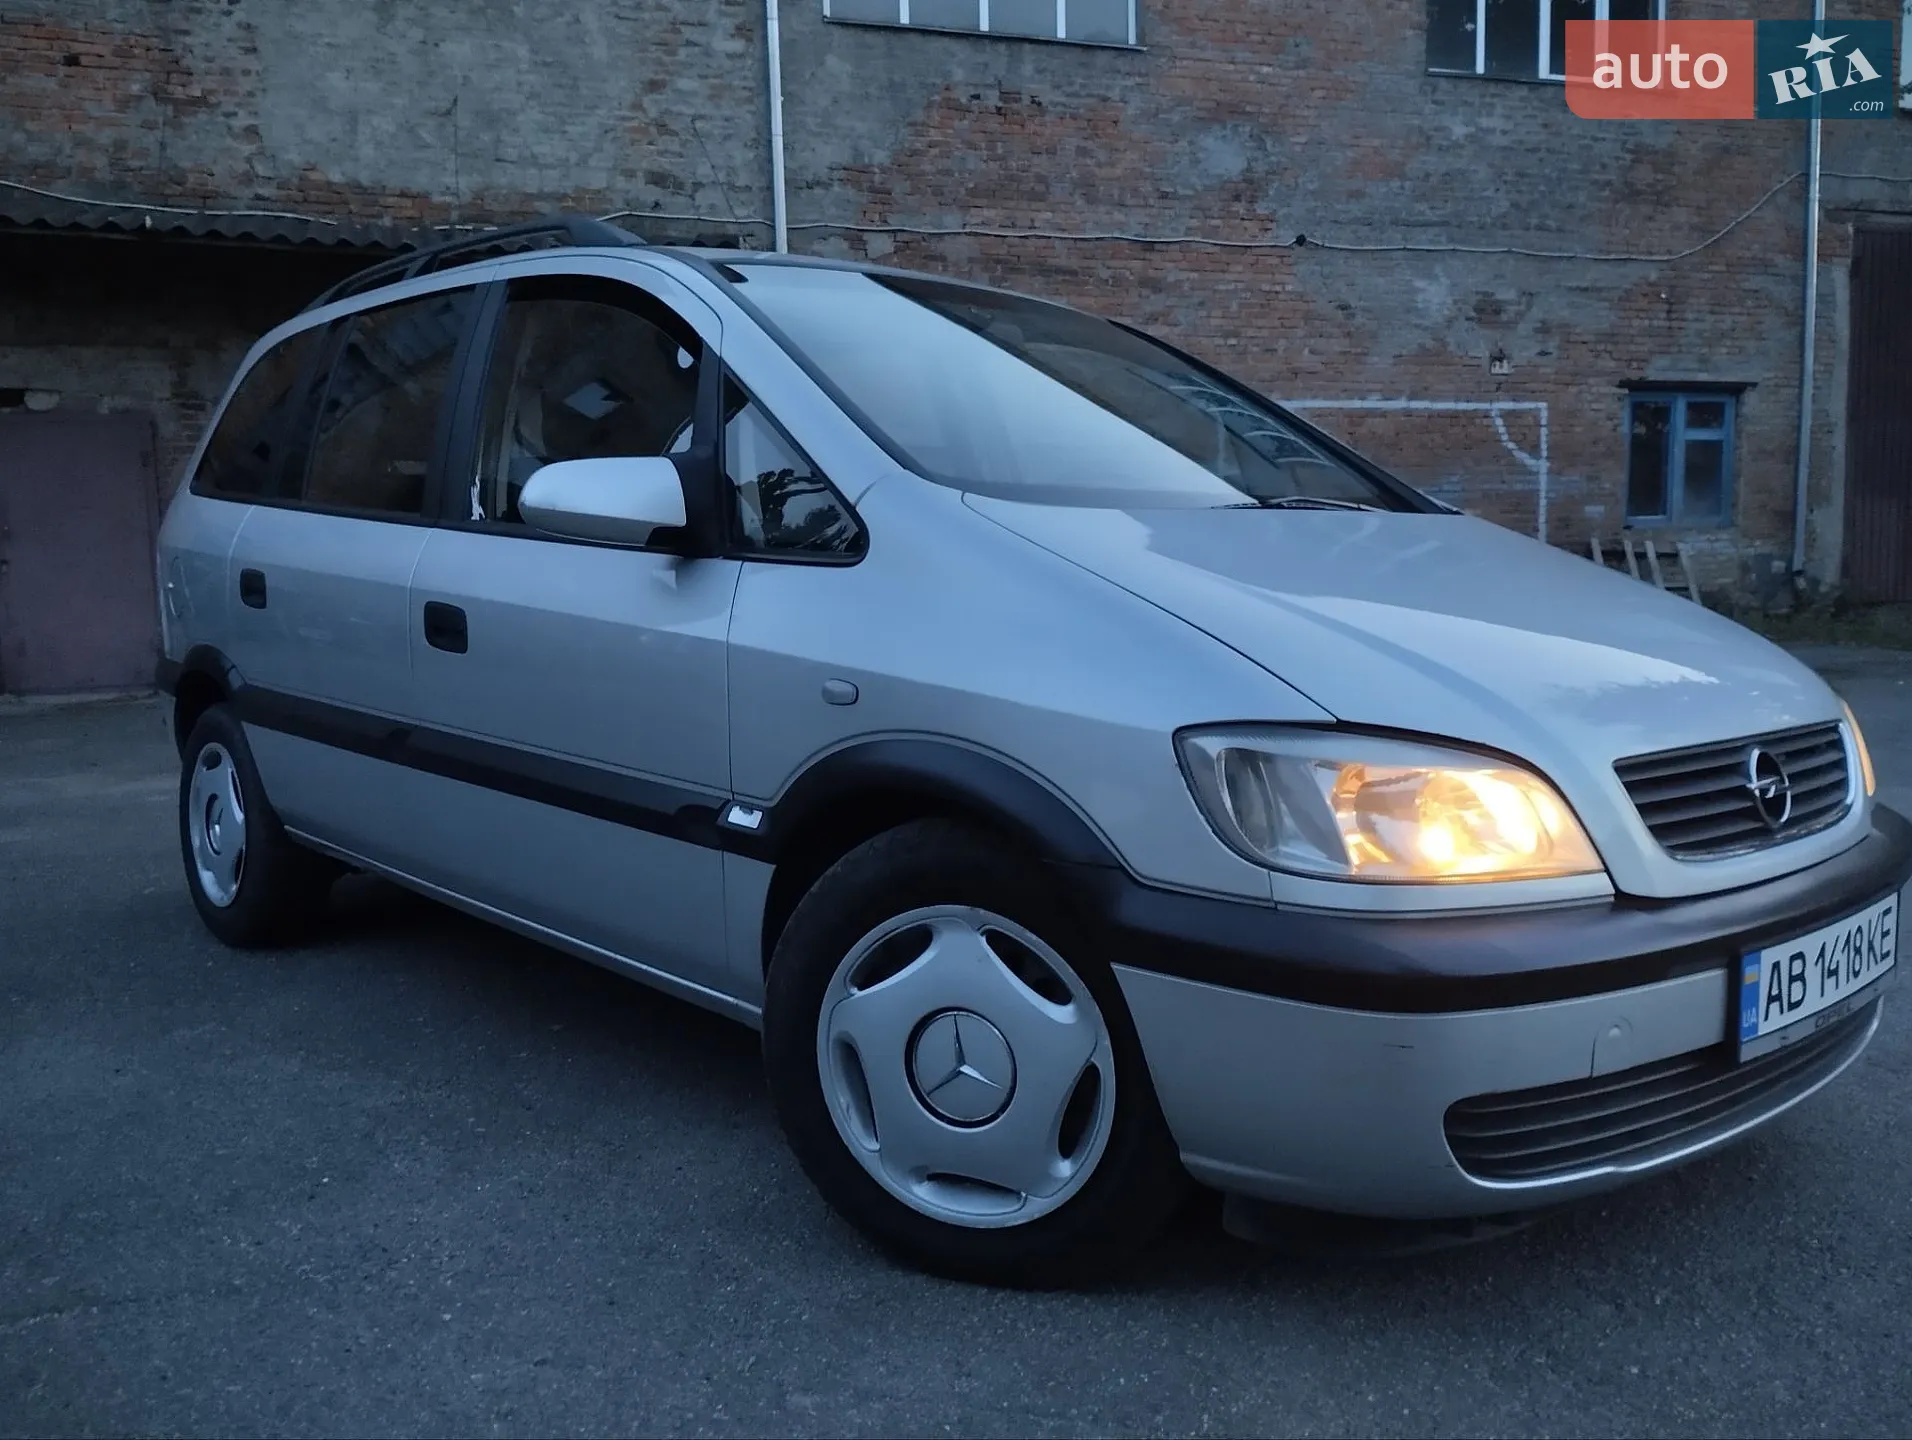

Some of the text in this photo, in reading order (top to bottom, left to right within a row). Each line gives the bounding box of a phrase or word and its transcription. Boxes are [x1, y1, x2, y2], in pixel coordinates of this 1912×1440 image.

[1763, 950, 1807, 1022] AB
[1814, 924, 1864, 998] 1418
[1866, 906, 1893, 972] KE
